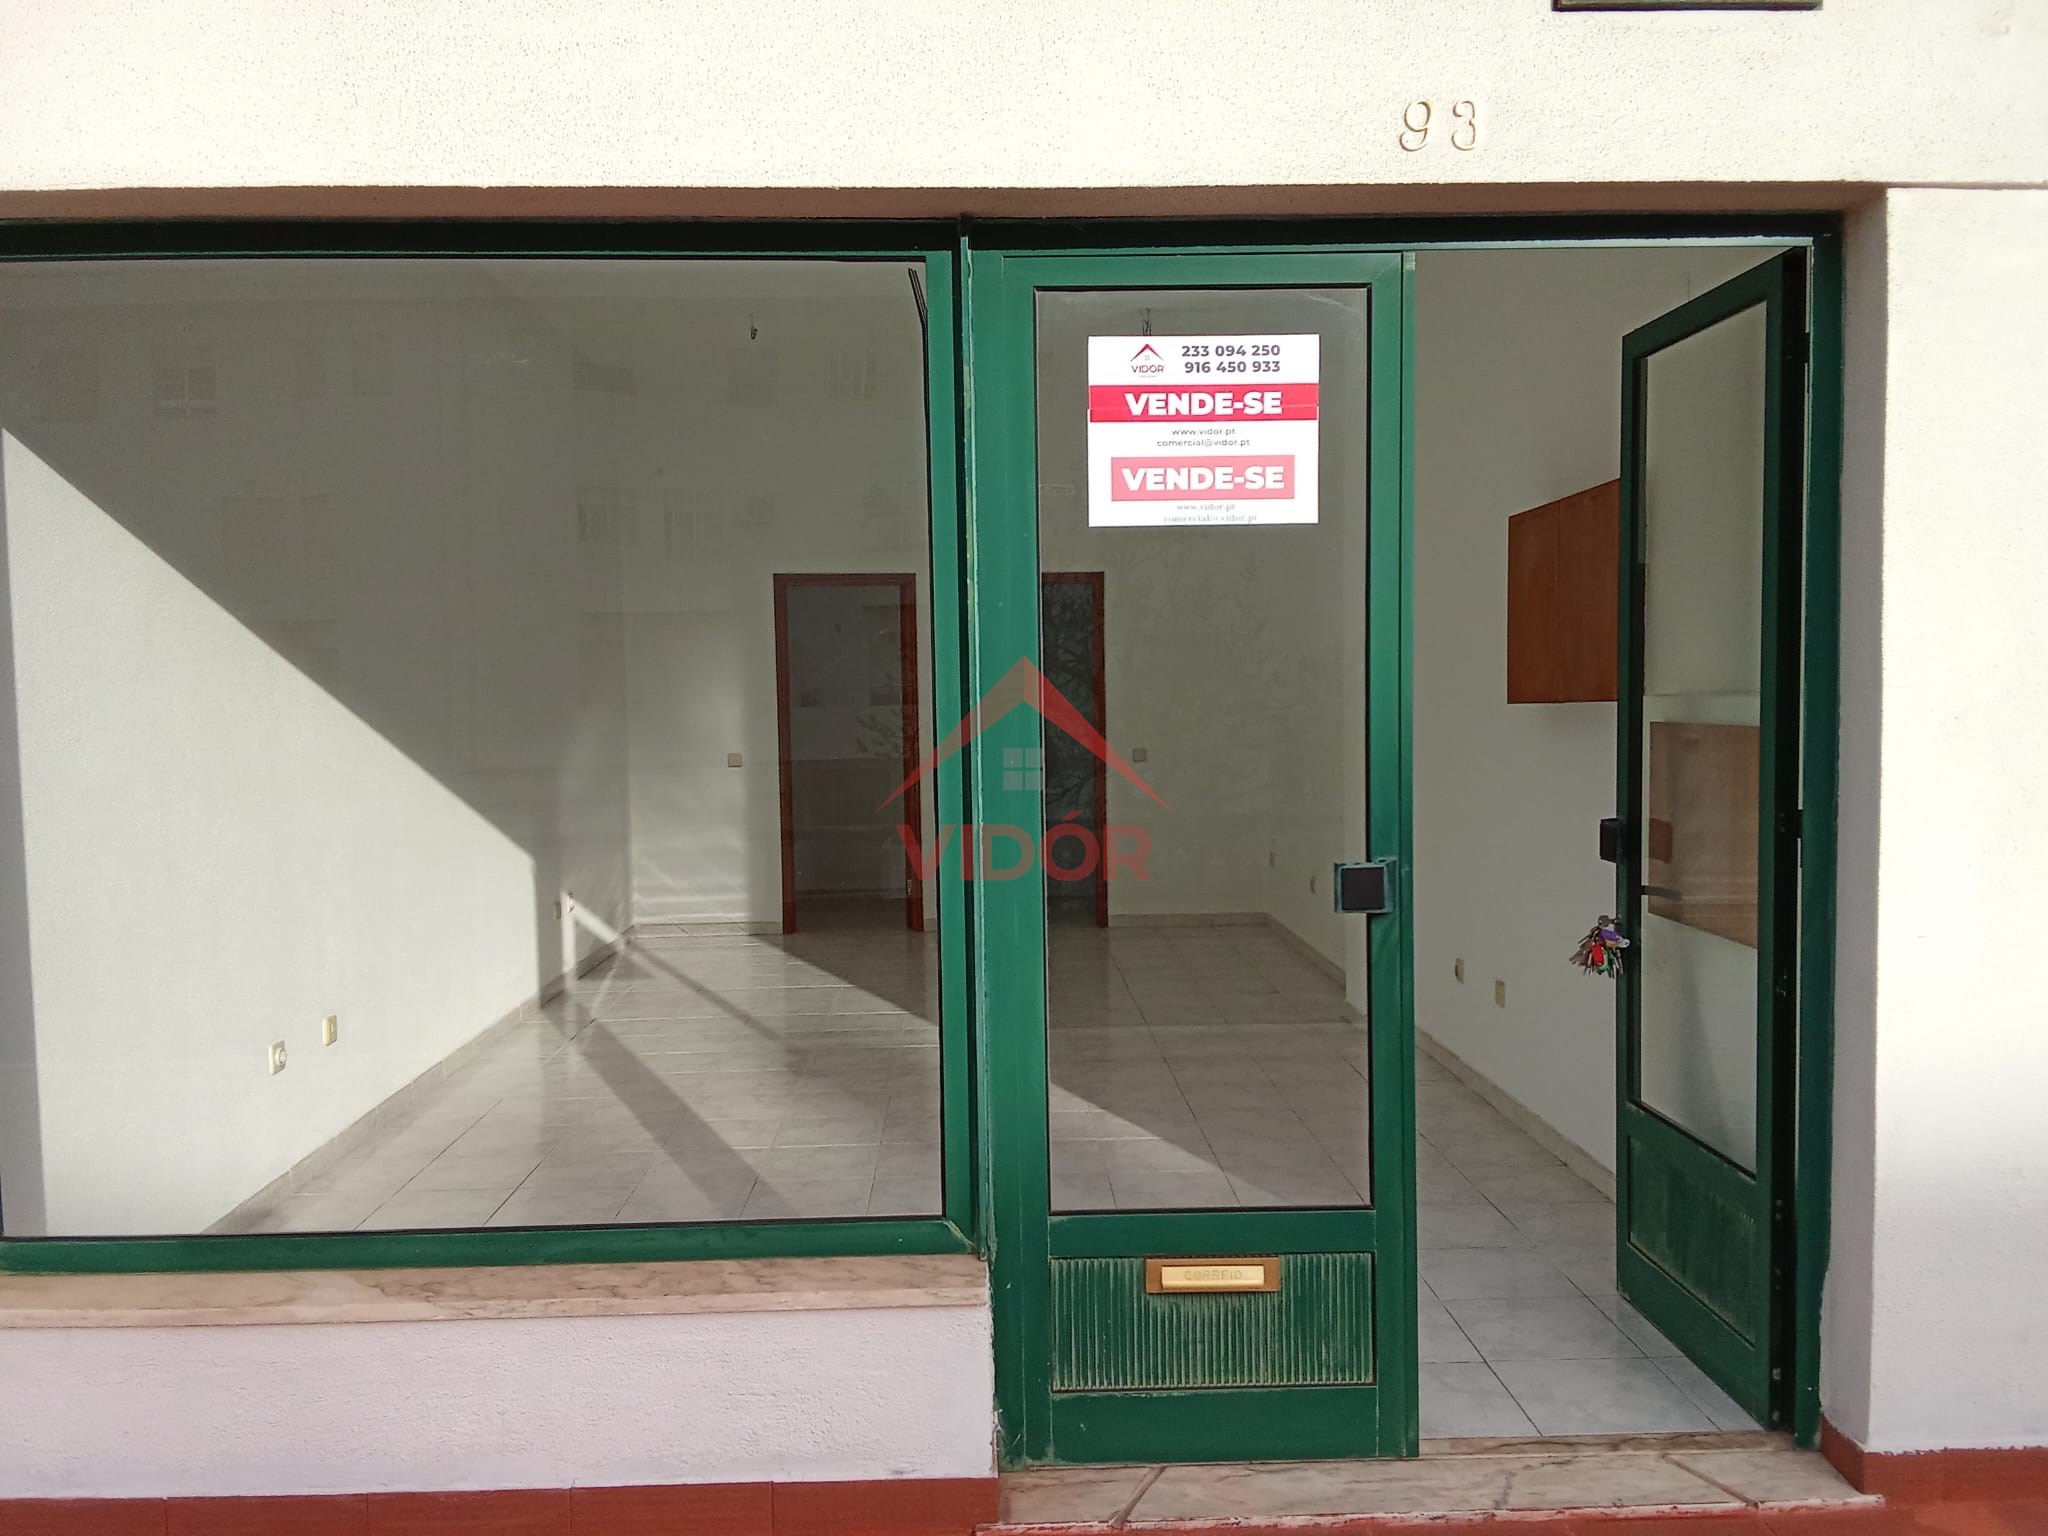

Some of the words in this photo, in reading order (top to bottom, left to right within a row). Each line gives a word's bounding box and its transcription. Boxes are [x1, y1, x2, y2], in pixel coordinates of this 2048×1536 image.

[1399, 100, 1476, 152] 93
[1181, 345, 1209, 357] 233
[1215, 345, 1246, 357] 094
[1251, 344, 1280, 356] 250
[1184, 361, 1211, 373] 916
[1216, 361, 1246, 373] 450
[1252, 360, 1280, 372] 933
[1124, 391, 1282, 416] VENDE-SE
[1172, 428, 1235, 436] www.vidor.pt
[1121, 466, 1285, 491] VENDE-SE
[1184, 1270, 1242, 1281] CORREIO
